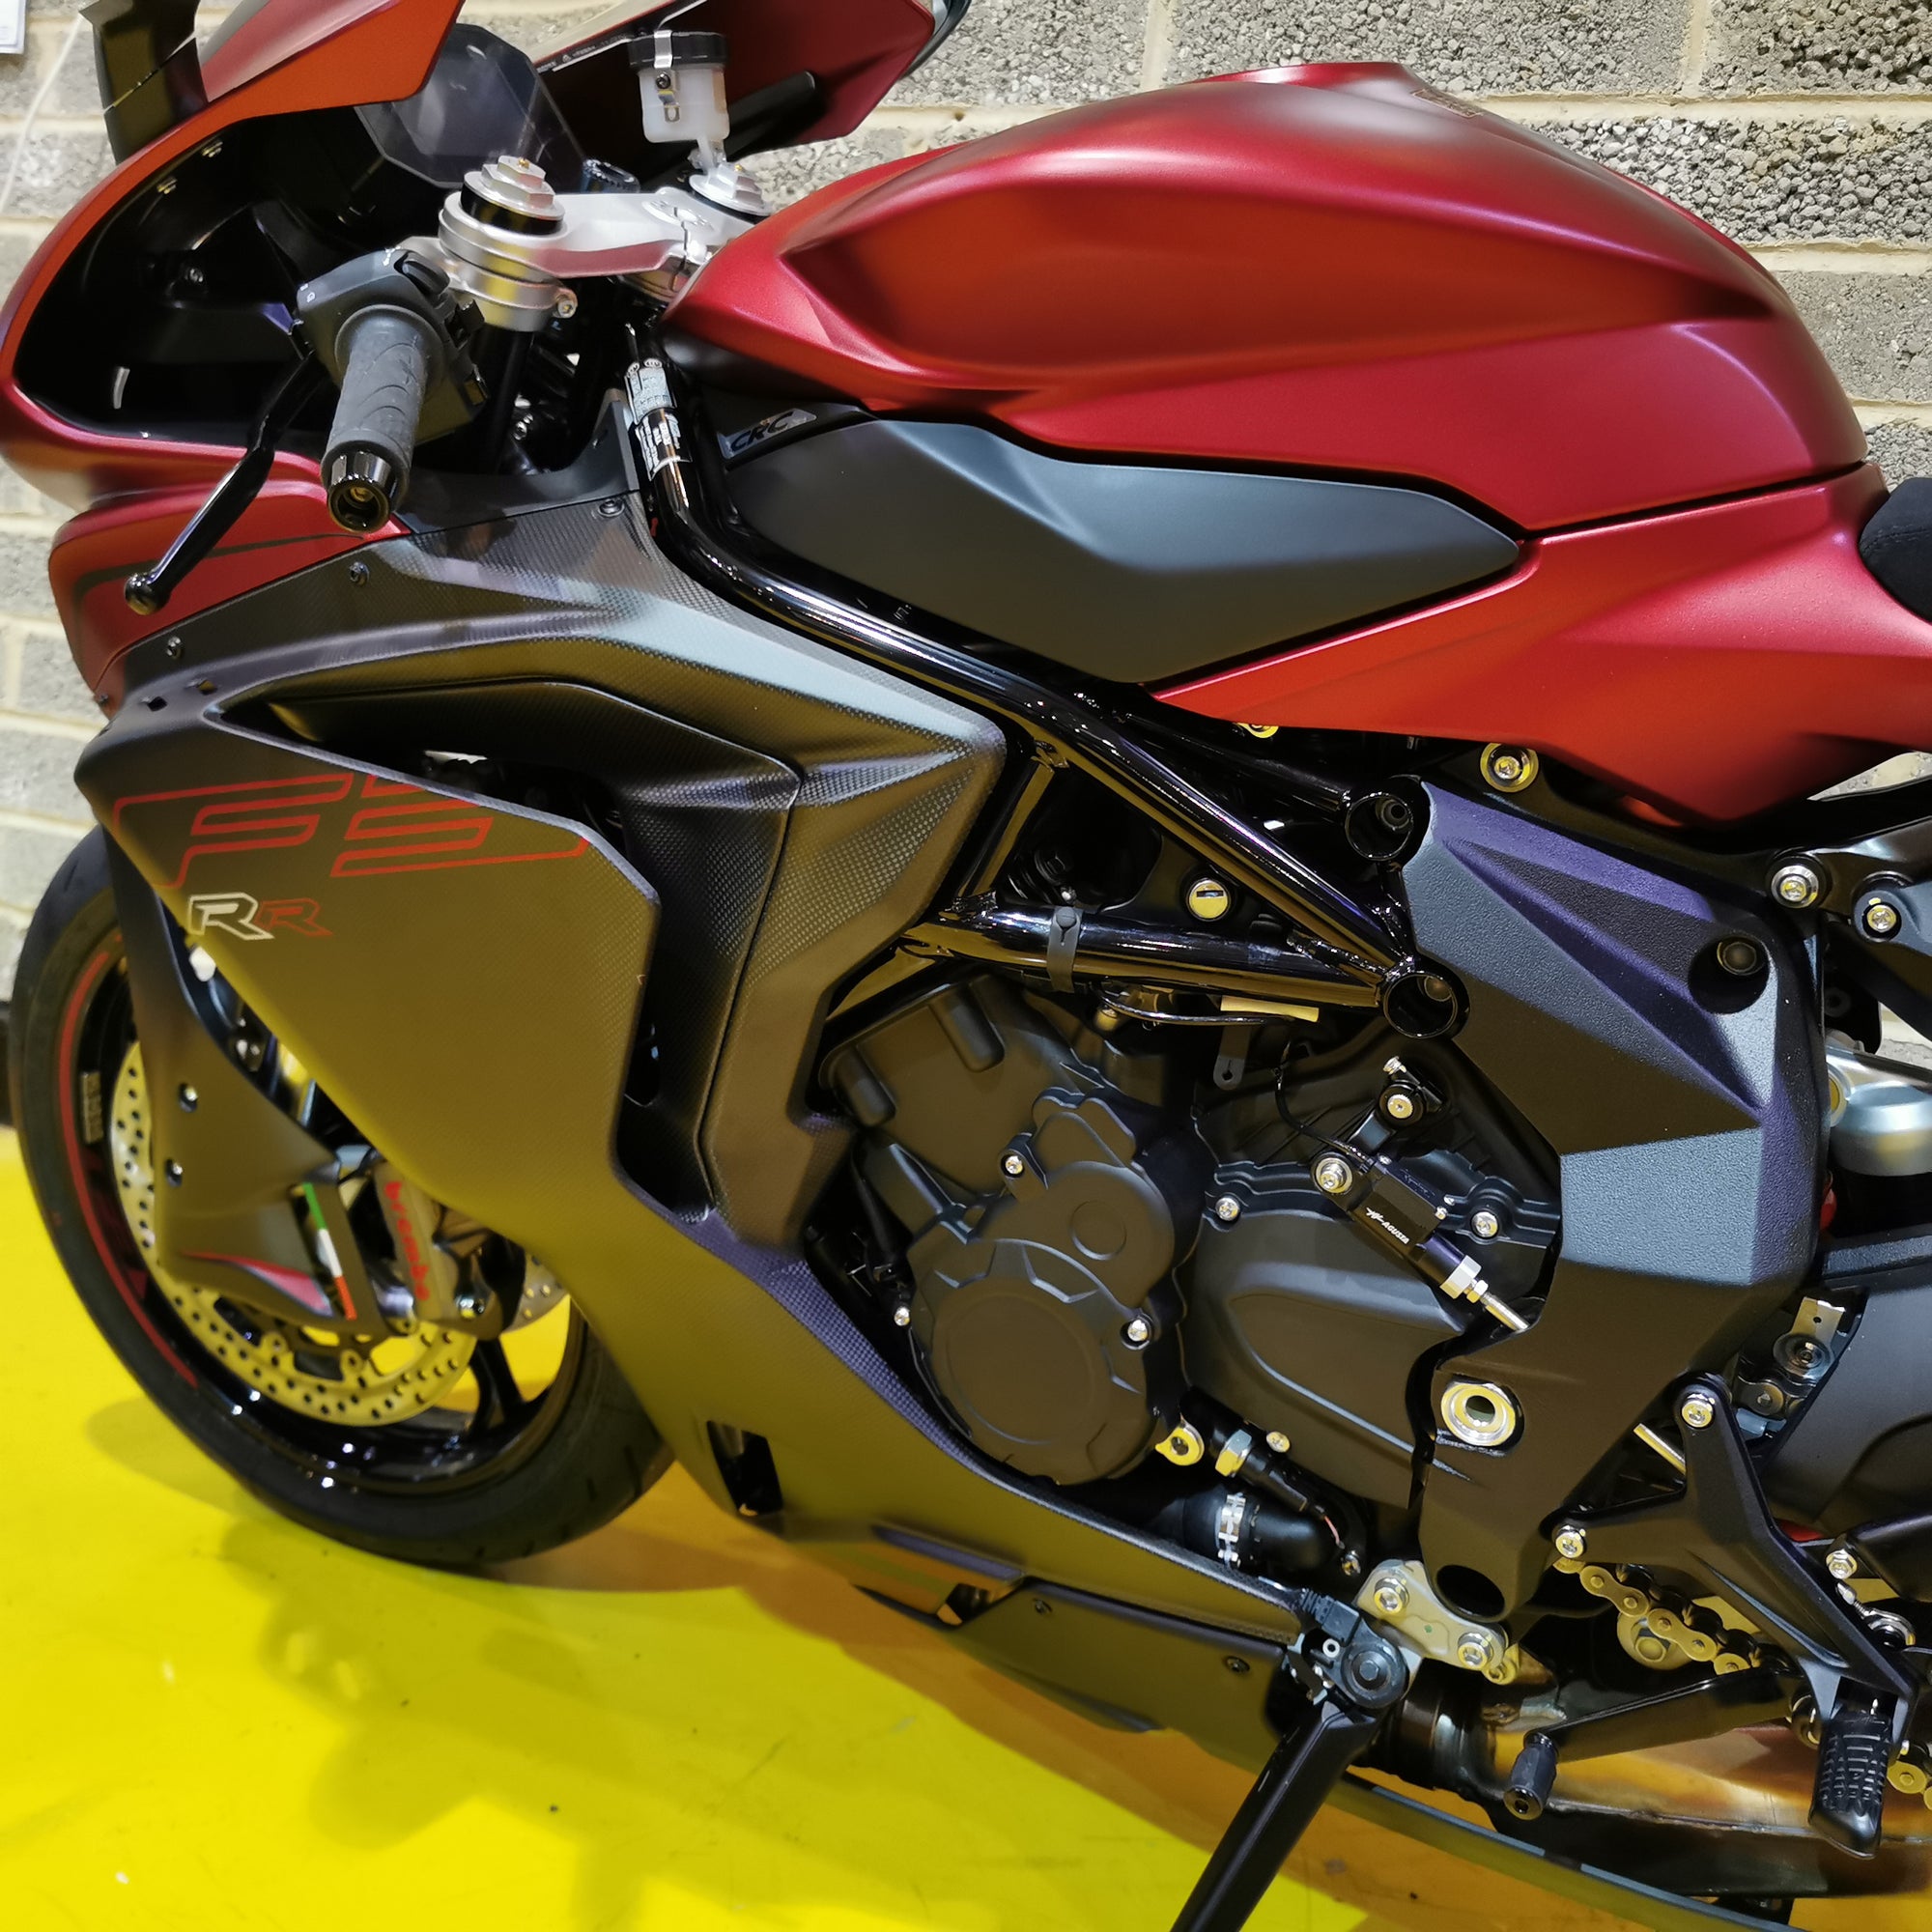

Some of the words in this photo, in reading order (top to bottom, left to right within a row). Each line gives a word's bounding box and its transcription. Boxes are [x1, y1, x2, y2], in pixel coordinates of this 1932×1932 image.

[730, 411, 794, 452] CRC
[187, 892, 334, 941] RR
[384, 1181, 430, 1301] brembo
[1381, 1221, 1410, 1245] AGUSTA
